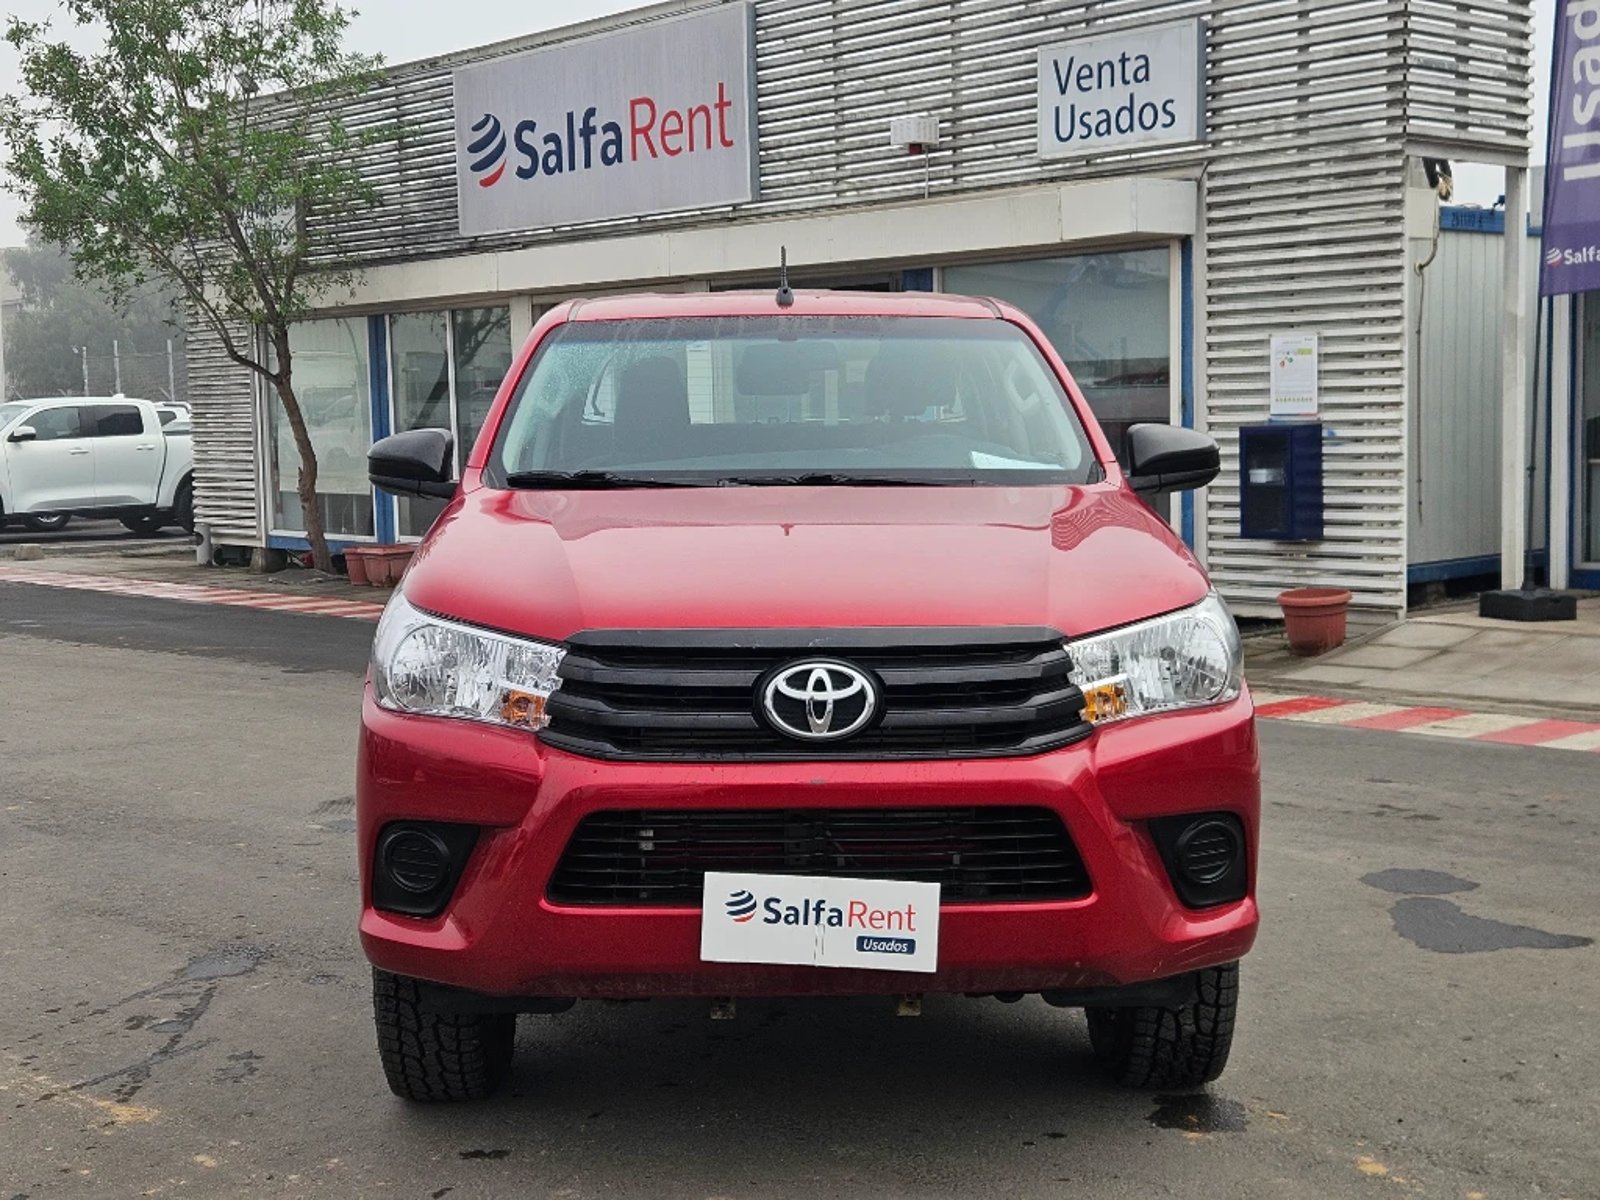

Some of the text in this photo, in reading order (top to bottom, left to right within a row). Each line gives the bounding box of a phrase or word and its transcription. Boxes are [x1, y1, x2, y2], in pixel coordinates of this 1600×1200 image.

[1053, 51, 1150, 96] Venta
[513, 82, 734, 180] SalfaRent
[1054, 93, 1176, 142] Usados
[763, 897, 916, 932] SalfaRent
[863, 937, 909, 953] Usados
